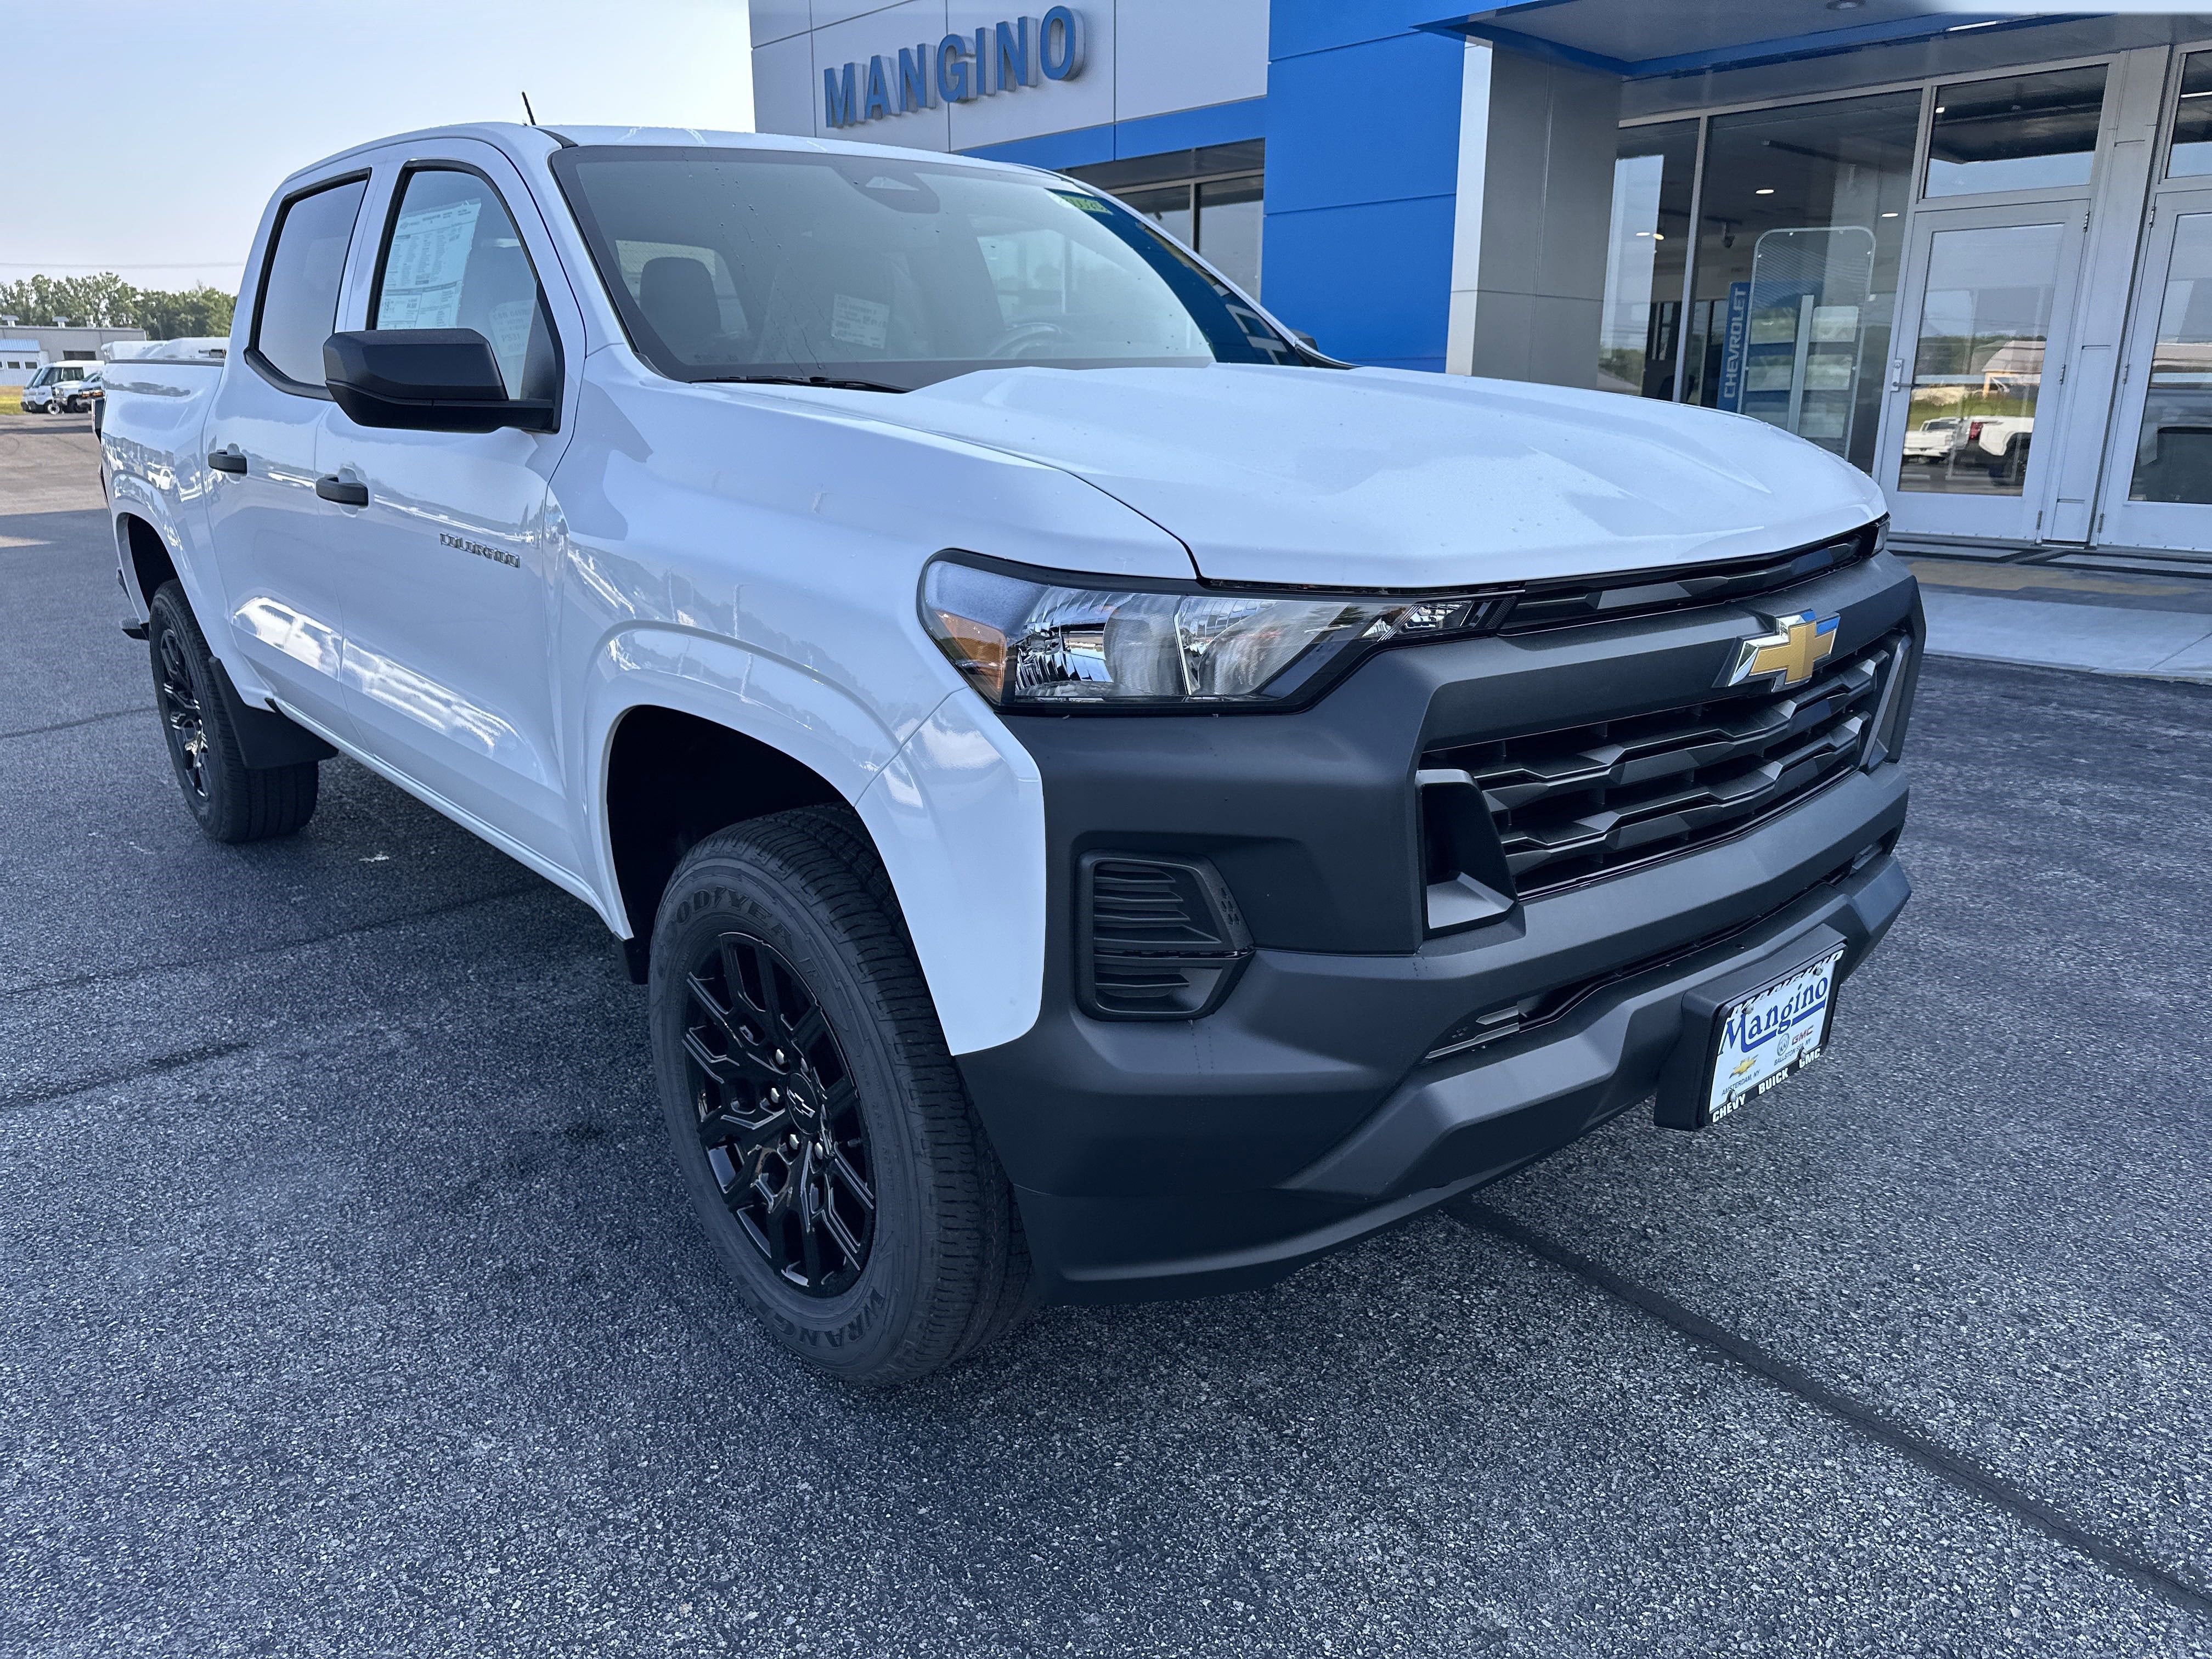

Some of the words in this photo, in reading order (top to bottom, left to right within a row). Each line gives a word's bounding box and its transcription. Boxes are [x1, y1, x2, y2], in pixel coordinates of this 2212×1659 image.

[824, 5, 1082, 128] MANGINO
[1724, 287, 1746, 398] CHEVROLET
[440, 533, 520, 568] COLORADO
[1718, 977, 1828, 1054] Mangino
[1791, 1025, 1814, 1046] GMC
[1753, 1069, 1760, 1079] NY
[1774, 1048, 1796, 1066] BALLSTON
[1712, 1093, 1746, 1123] CHEVY
[1758, 1068, 1789, 1095] BUICK
[1799, 1048, 1821, 1069] GMC
